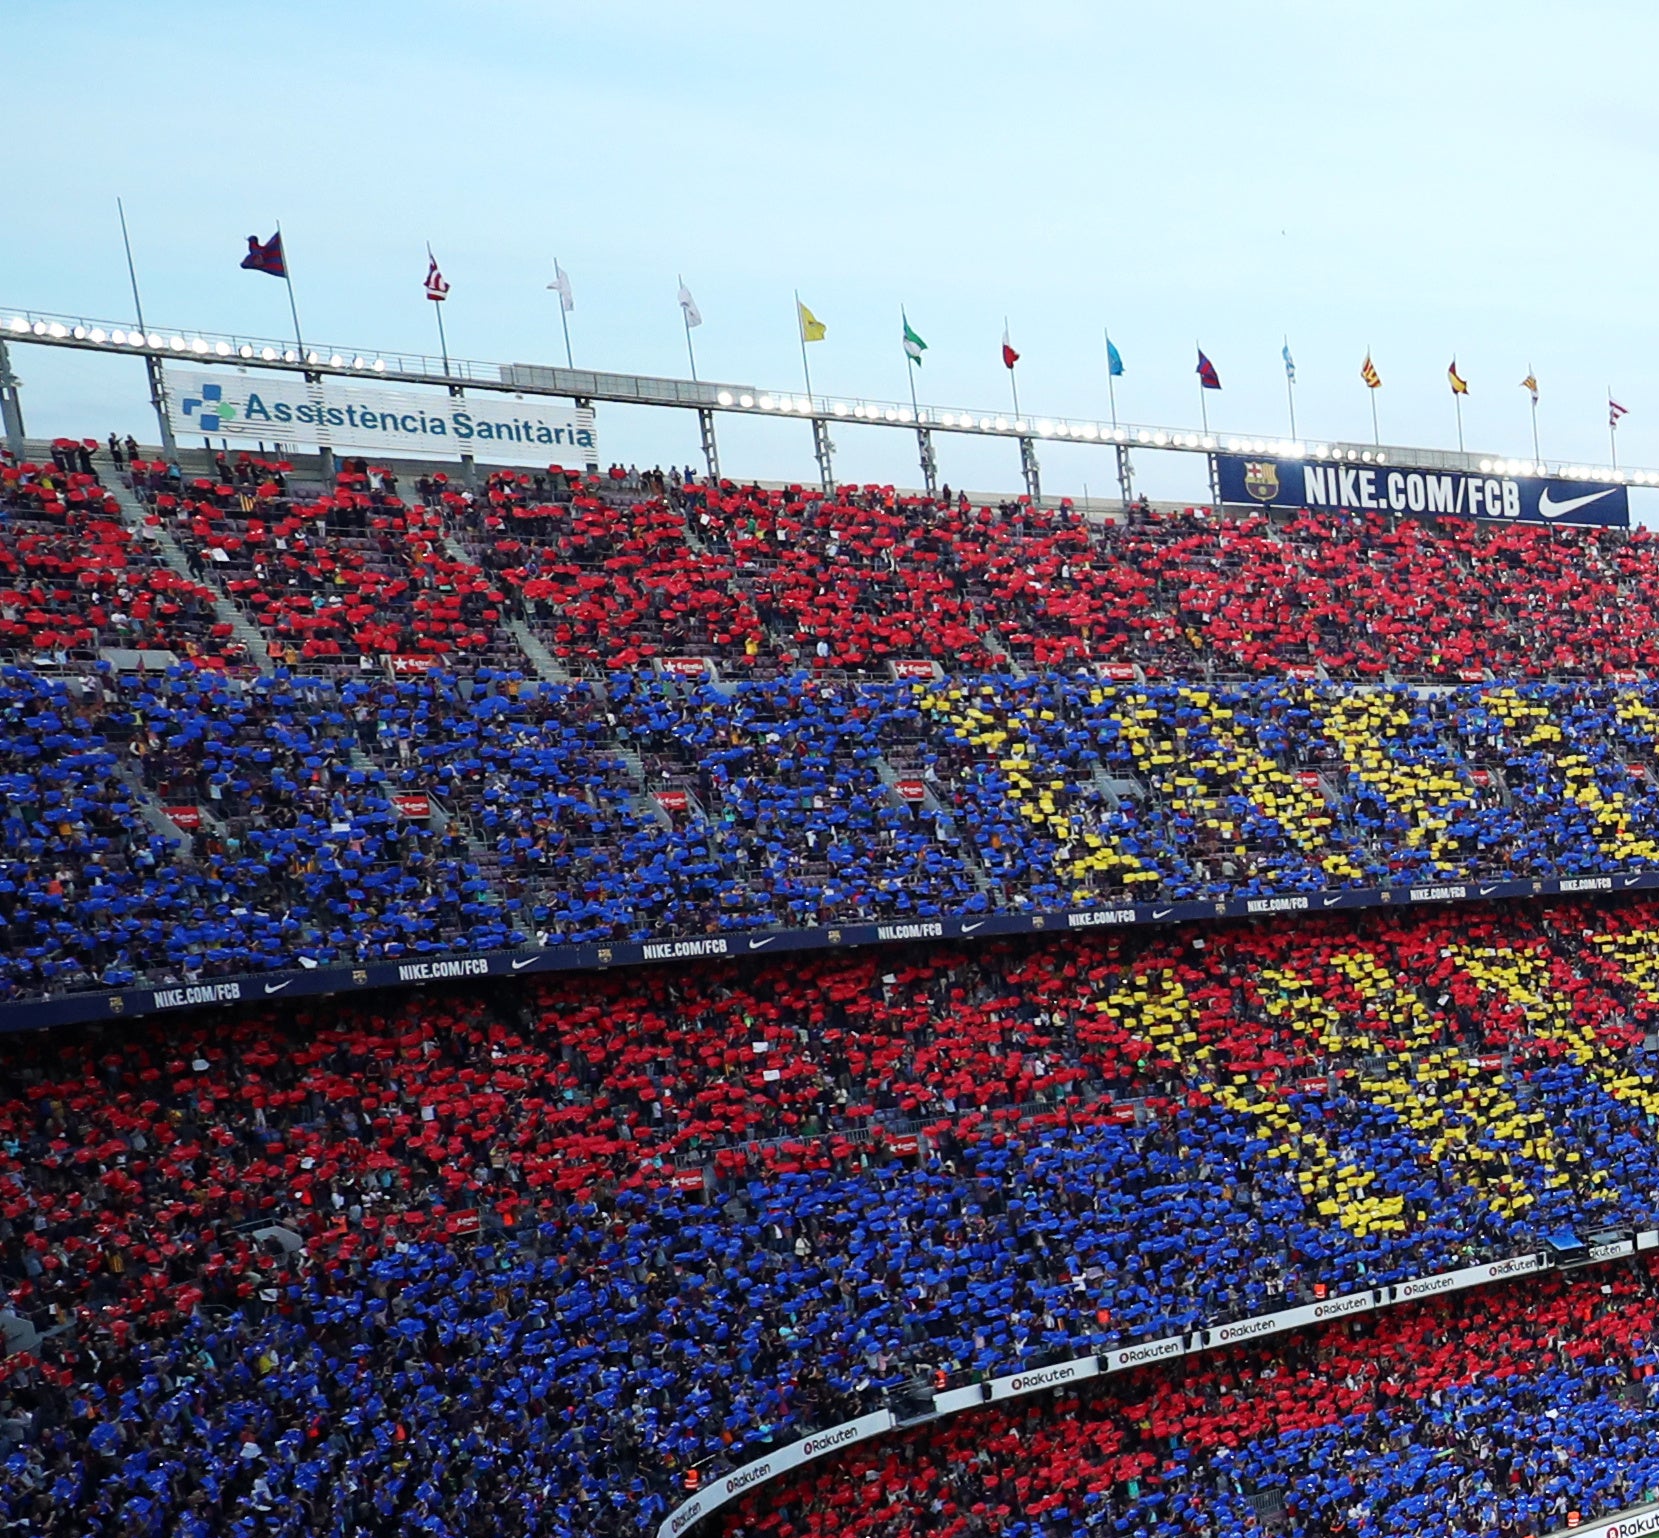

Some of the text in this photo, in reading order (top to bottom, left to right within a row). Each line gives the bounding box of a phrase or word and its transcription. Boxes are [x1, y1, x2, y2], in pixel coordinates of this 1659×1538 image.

[245, 393, 594, 449] Assistència Sanitària
[1303, 465, 1520, 518] NIKE.COM/FCB
[1247, 897, 1308, 913] NIKE.COM/FCB
[1068, 909, 1136, 927] NIKE.COM/FCB
[643, 938, 728, 961] NIKE.COM/FCB
[399, 959, 489, 982] NIKE.COM/FCB
[154, 983, 241, 1010] NIKE.COM/FCB
[1496, 1258, 1537, 1275] Rakuten
[1412, 1276, 1454, 1295] Rakuten
[1322, 1298, 1367, 1317] Rakuten
[1229, 1318, 1276, 1339] Rakuten
[1129, 1341, 1179, 1364] Rakuten
[1022, 1366, 1075, 1389] Rakuten
[812, 1426, 858, 1452] Rakuten
[733, 1462, 772, 1487] Rakuten
[679, 1502, 701, 1528] Rakuten
